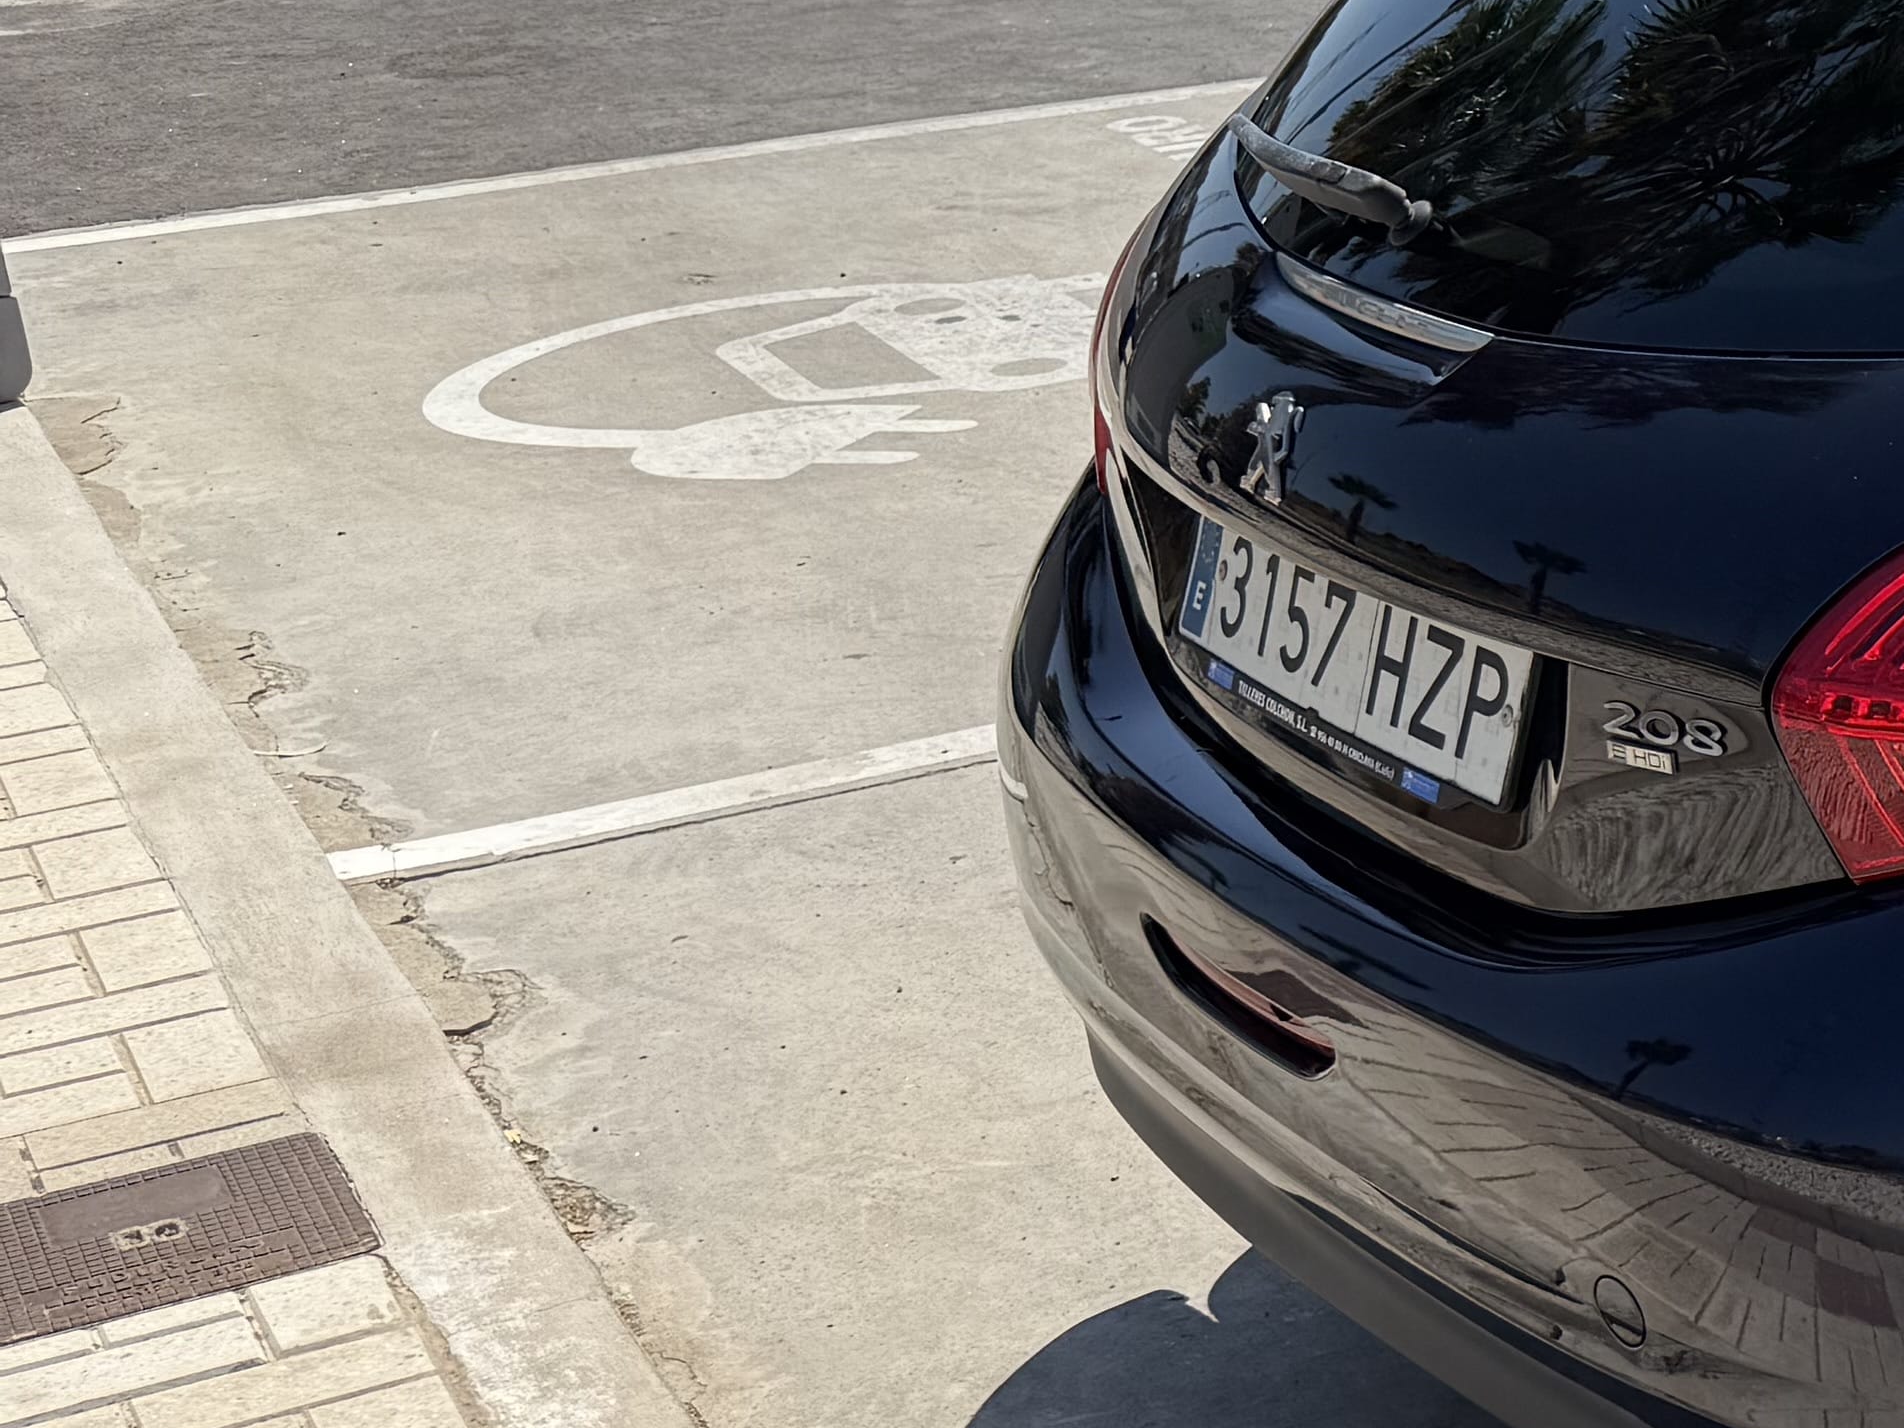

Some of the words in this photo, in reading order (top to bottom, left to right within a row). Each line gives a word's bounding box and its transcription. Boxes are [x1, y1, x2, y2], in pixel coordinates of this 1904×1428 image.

[1192, 579, 1208, 611] E
[1219, 534, 1357, 688] 3157
[1364, 603, 1510, 760] HZP
[1602, 699, 1724, 757] 208
